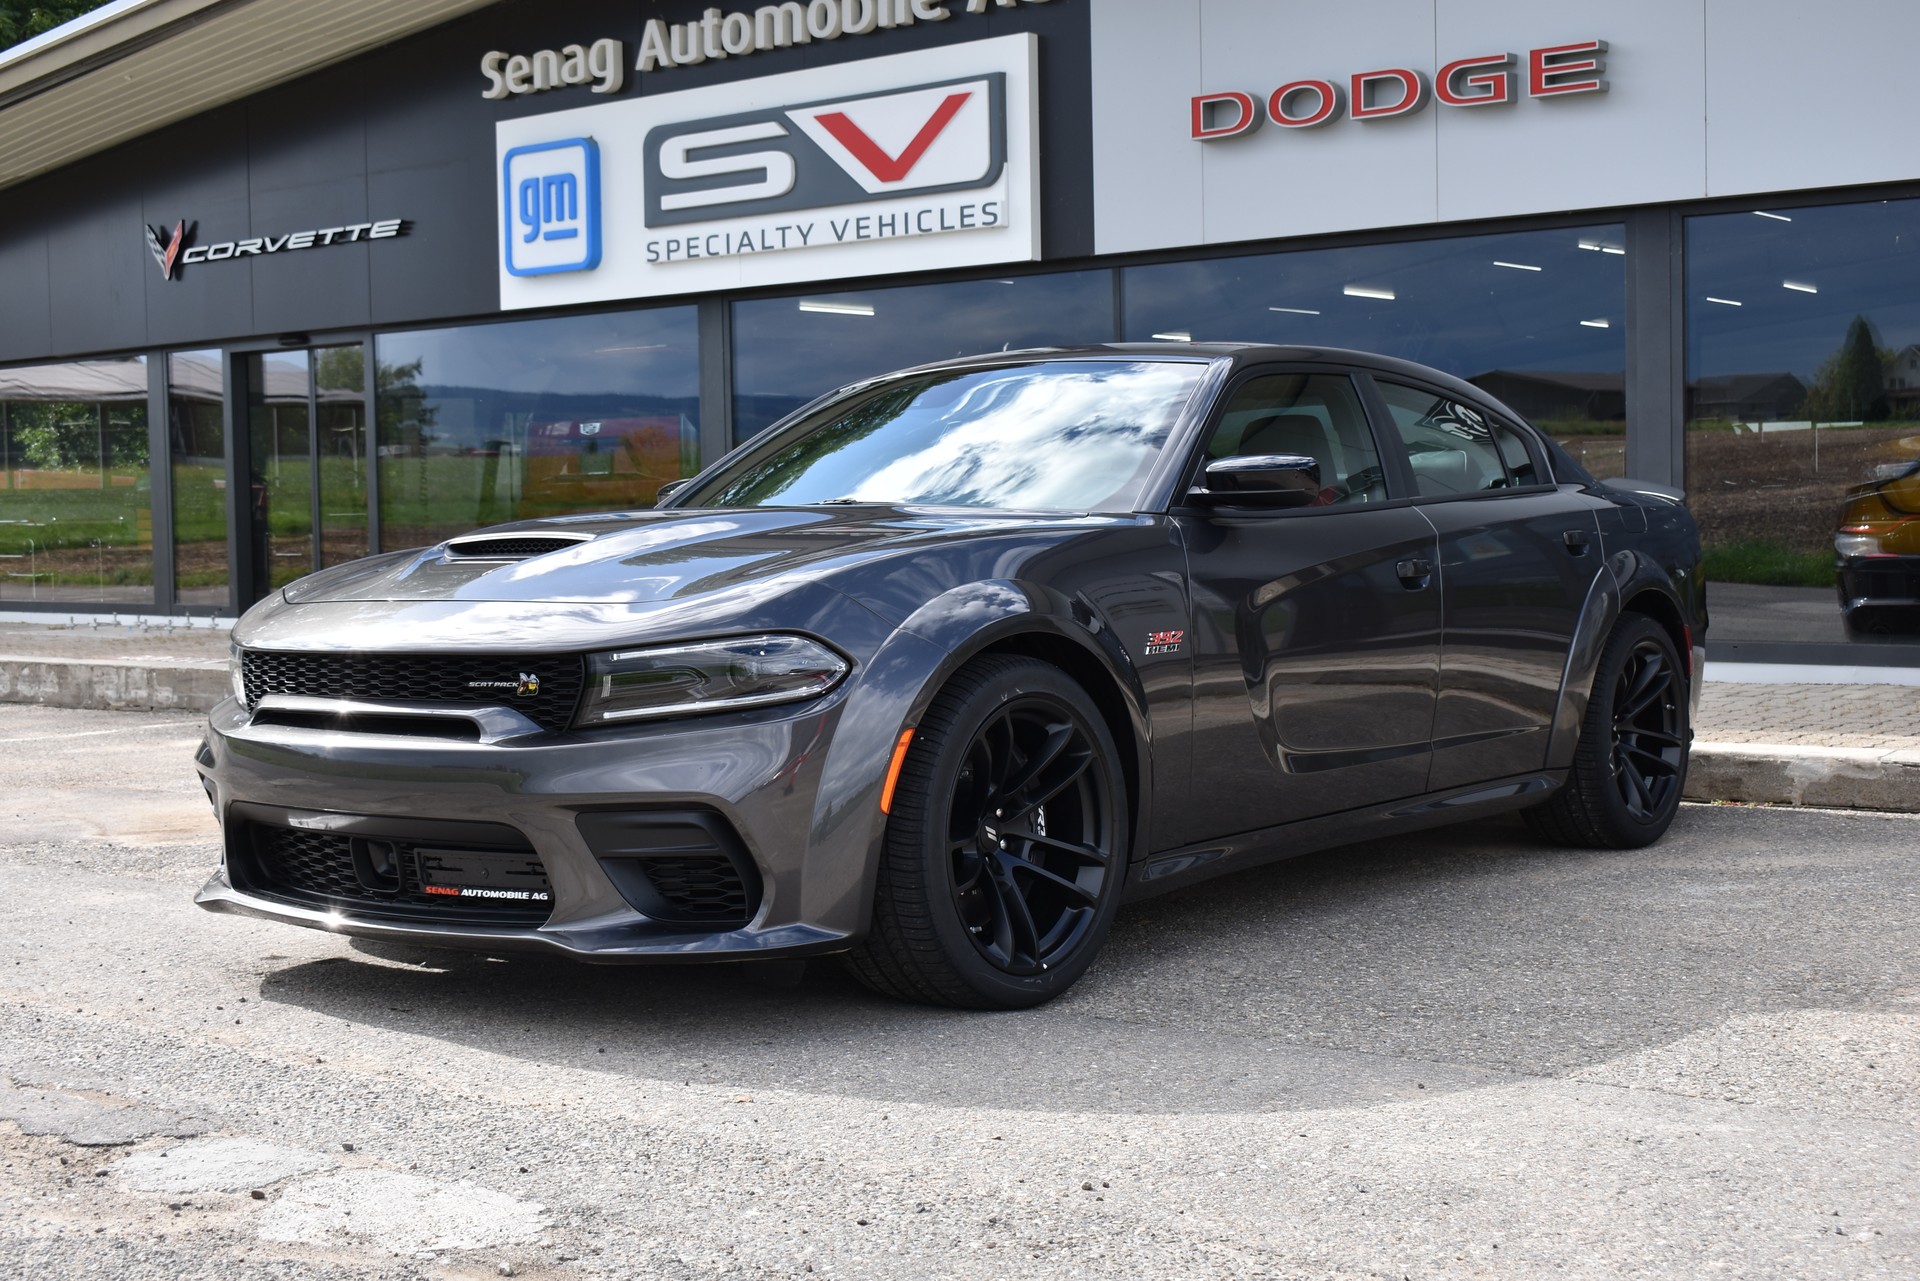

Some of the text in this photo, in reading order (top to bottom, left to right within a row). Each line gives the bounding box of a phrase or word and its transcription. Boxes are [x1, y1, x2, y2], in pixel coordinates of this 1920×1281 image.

[481, 38, 623, 100] Senag
[1191, 40, 1608, 142] DODGE
[519, 172, 578, 244] gm
[646, 201, 1000, 263] SPECIALTY VEHICLES
[182, 219, 403, 264] CORVETTE
[1147, 630, 1184, 646] 392
[425, 886, 548, 901] SENAG AUTOMOBILE AG
